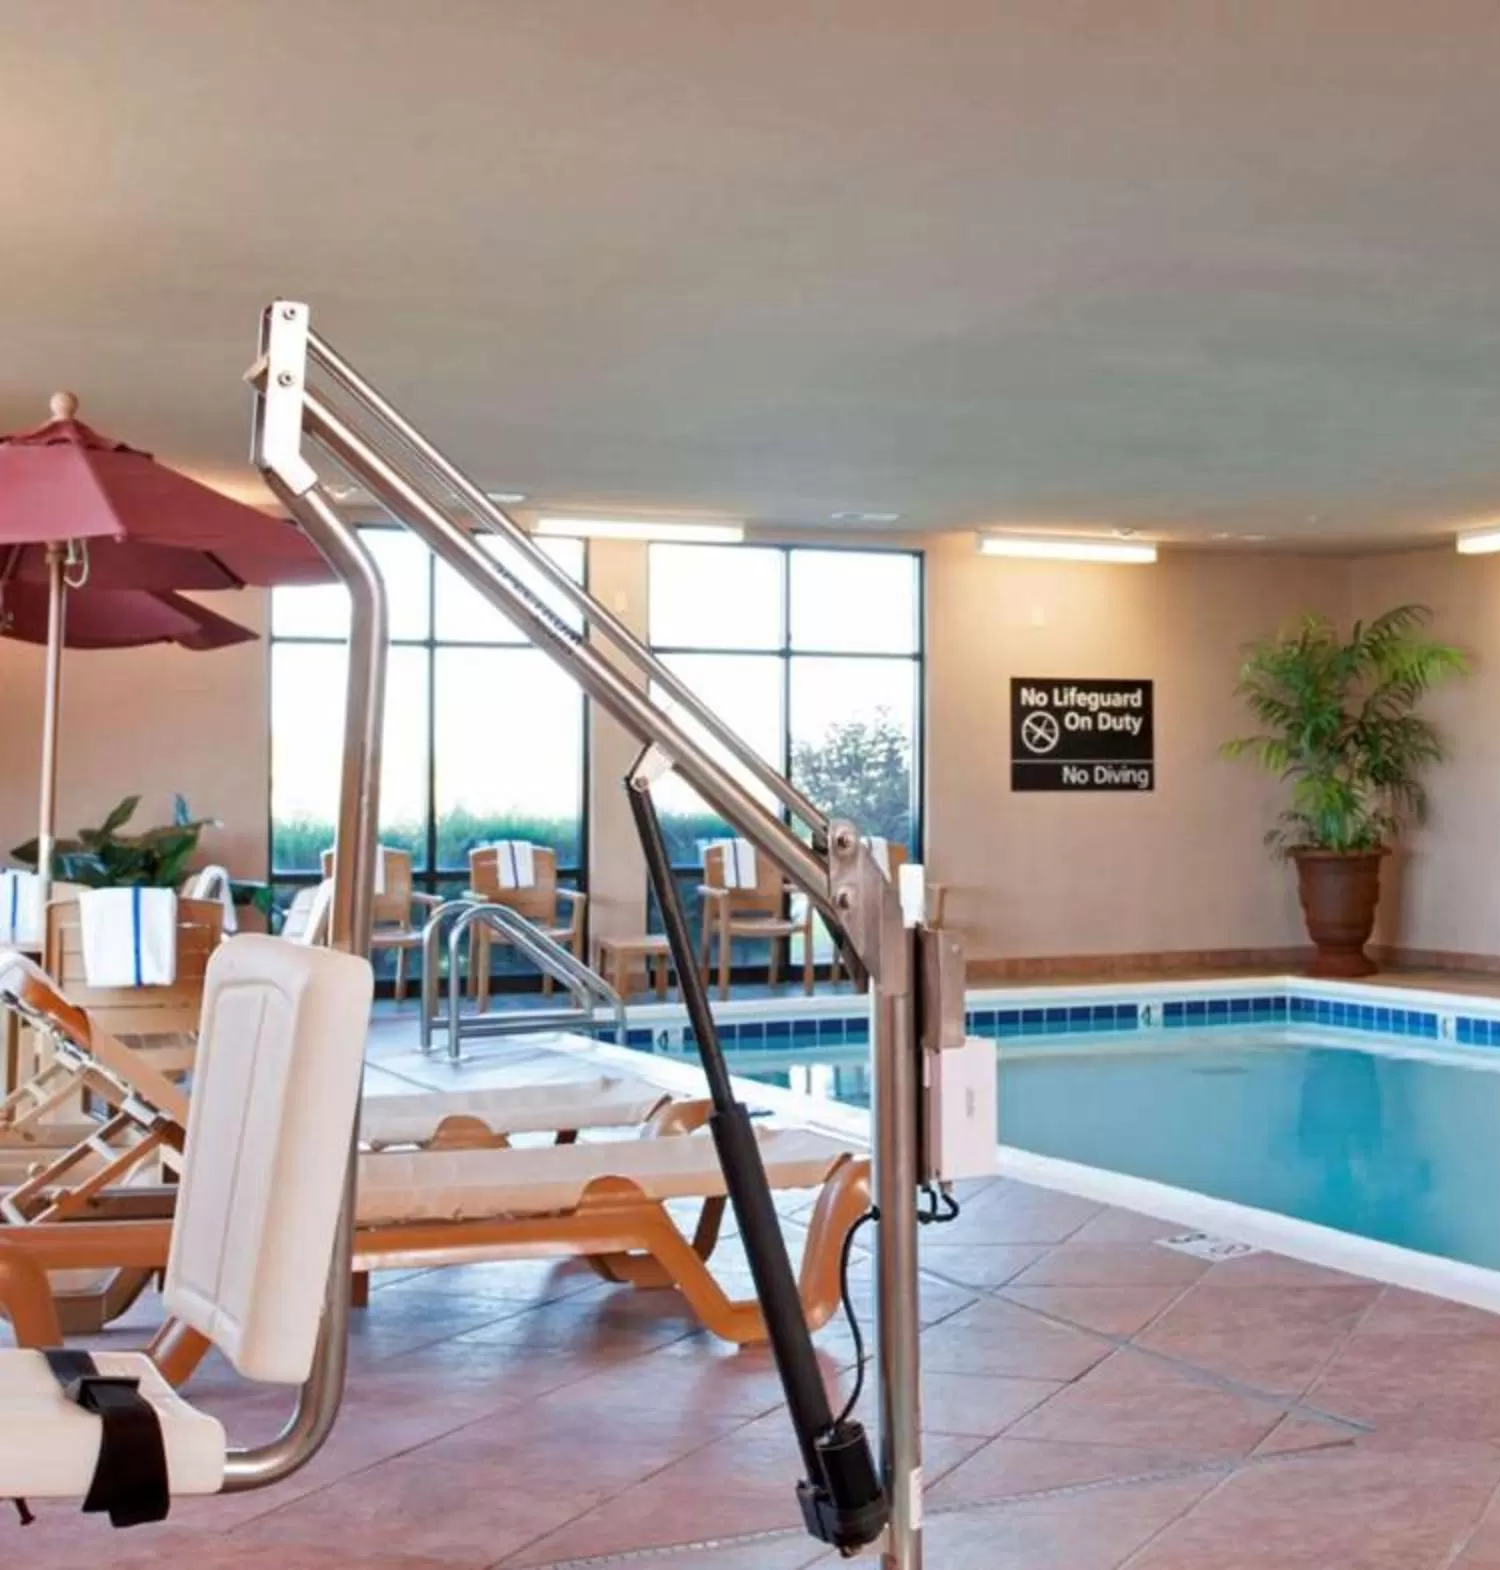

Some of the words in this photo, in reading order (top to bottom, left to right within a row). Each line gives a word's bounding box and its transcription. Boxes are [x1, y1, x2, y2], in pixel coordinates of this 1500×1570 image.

[1020, 687, 1048, 706] No
[1053, 687, 1143, 712] Lifeguard
[1064, 711, 1093, 731] On
[1098, 712, 1143, 736] Duty
[1062, 766, 1089, 784] No
[1093, 766, 1149, 788] Diving
